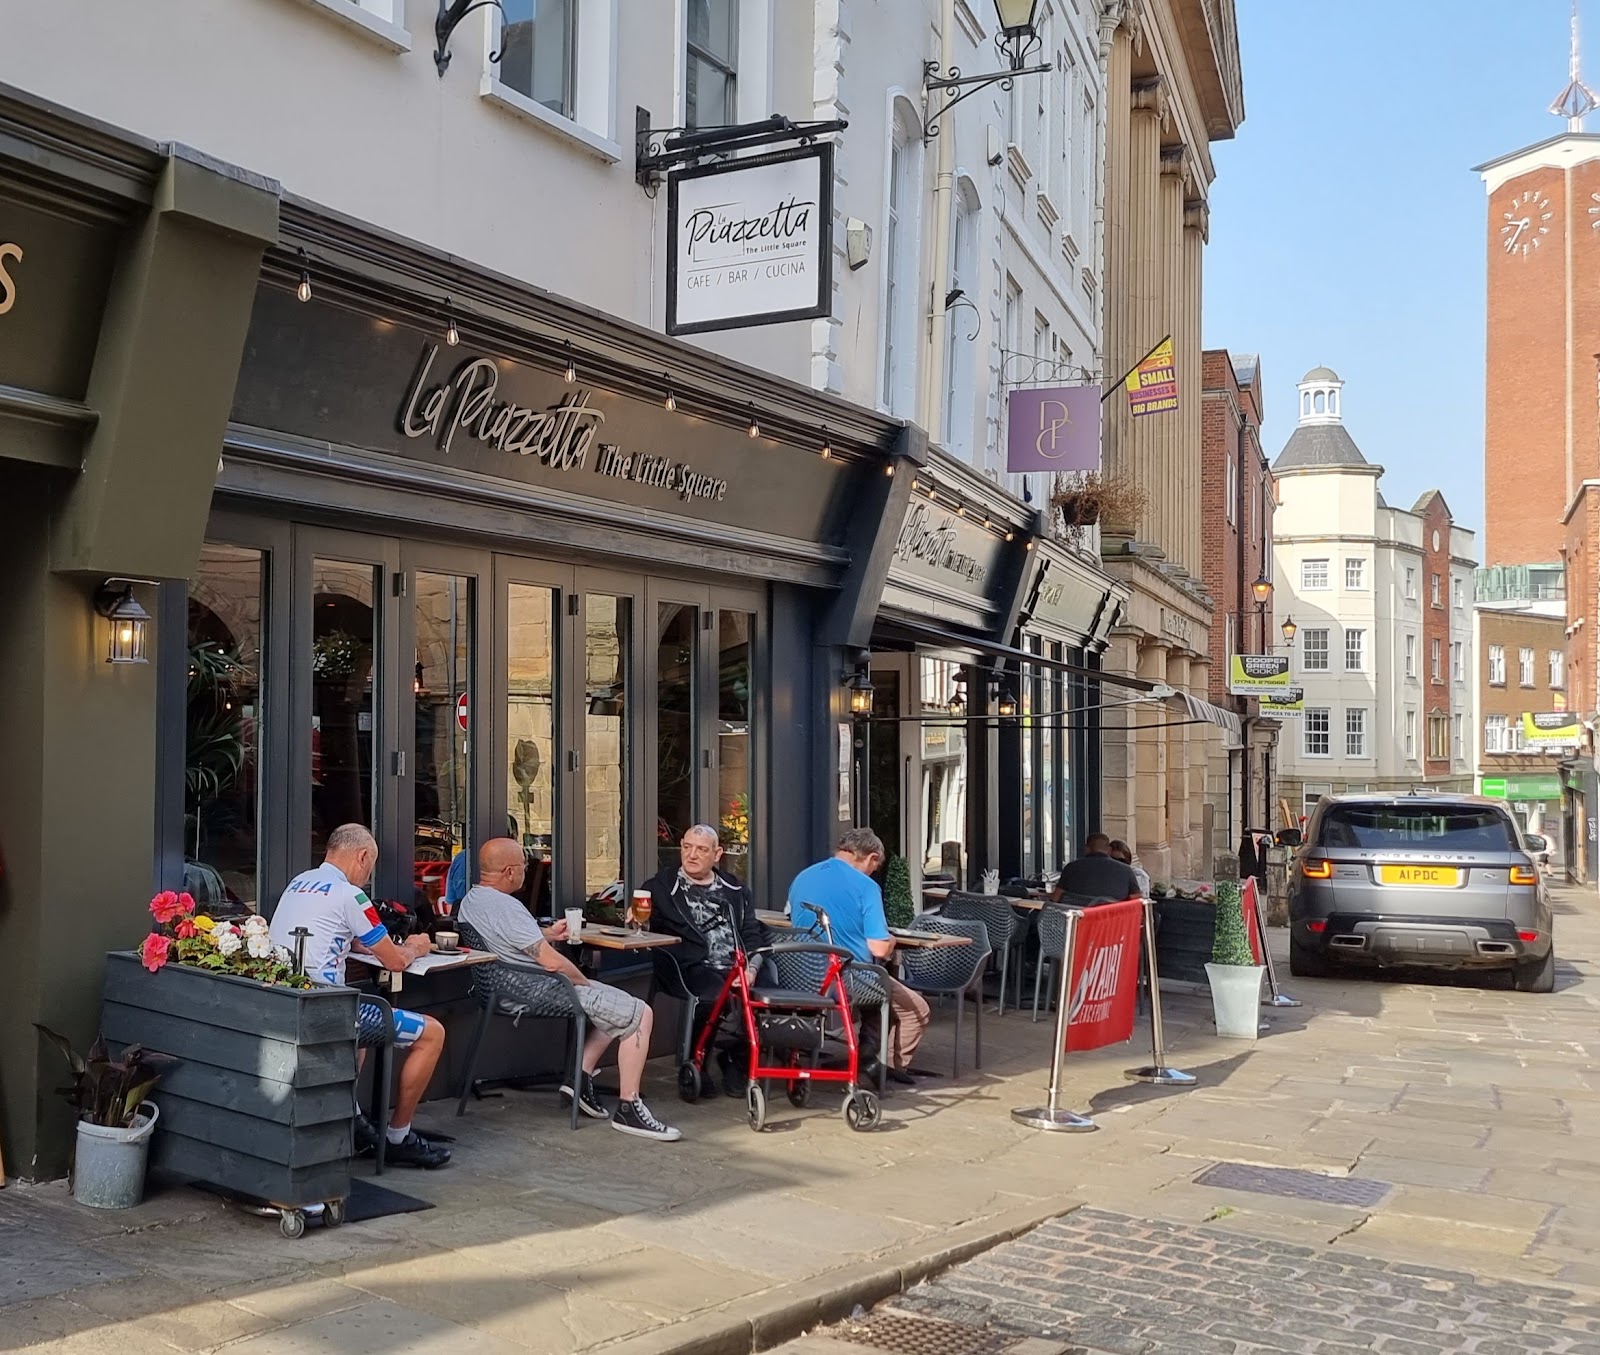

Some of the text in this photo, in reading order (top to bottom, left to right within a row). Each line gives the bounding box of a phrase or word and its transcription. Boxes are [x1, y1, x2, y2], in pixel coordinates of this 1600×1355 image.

[685, 197, 815, 256] Piazzetta
[746, 239, 807, 255] The Little Square
[687, 274, 711, 290] CAFE
[728, 269, 748, 284] BAR
[765, 261, 806, 279] CUCINA
[1140, 368, 1175, 386] SMALL
[1129, 387, 1170, 400] BUSINESSES
[402, 344, 606, 472] La Piazzetta
[1132, 397, 1178, 415] BIG BRANDS
[601, 444, 728, 503] The Little Square
[1399, 869, 1438, 881] A1 PDC
[288, 879, 333, 897] ALIA
